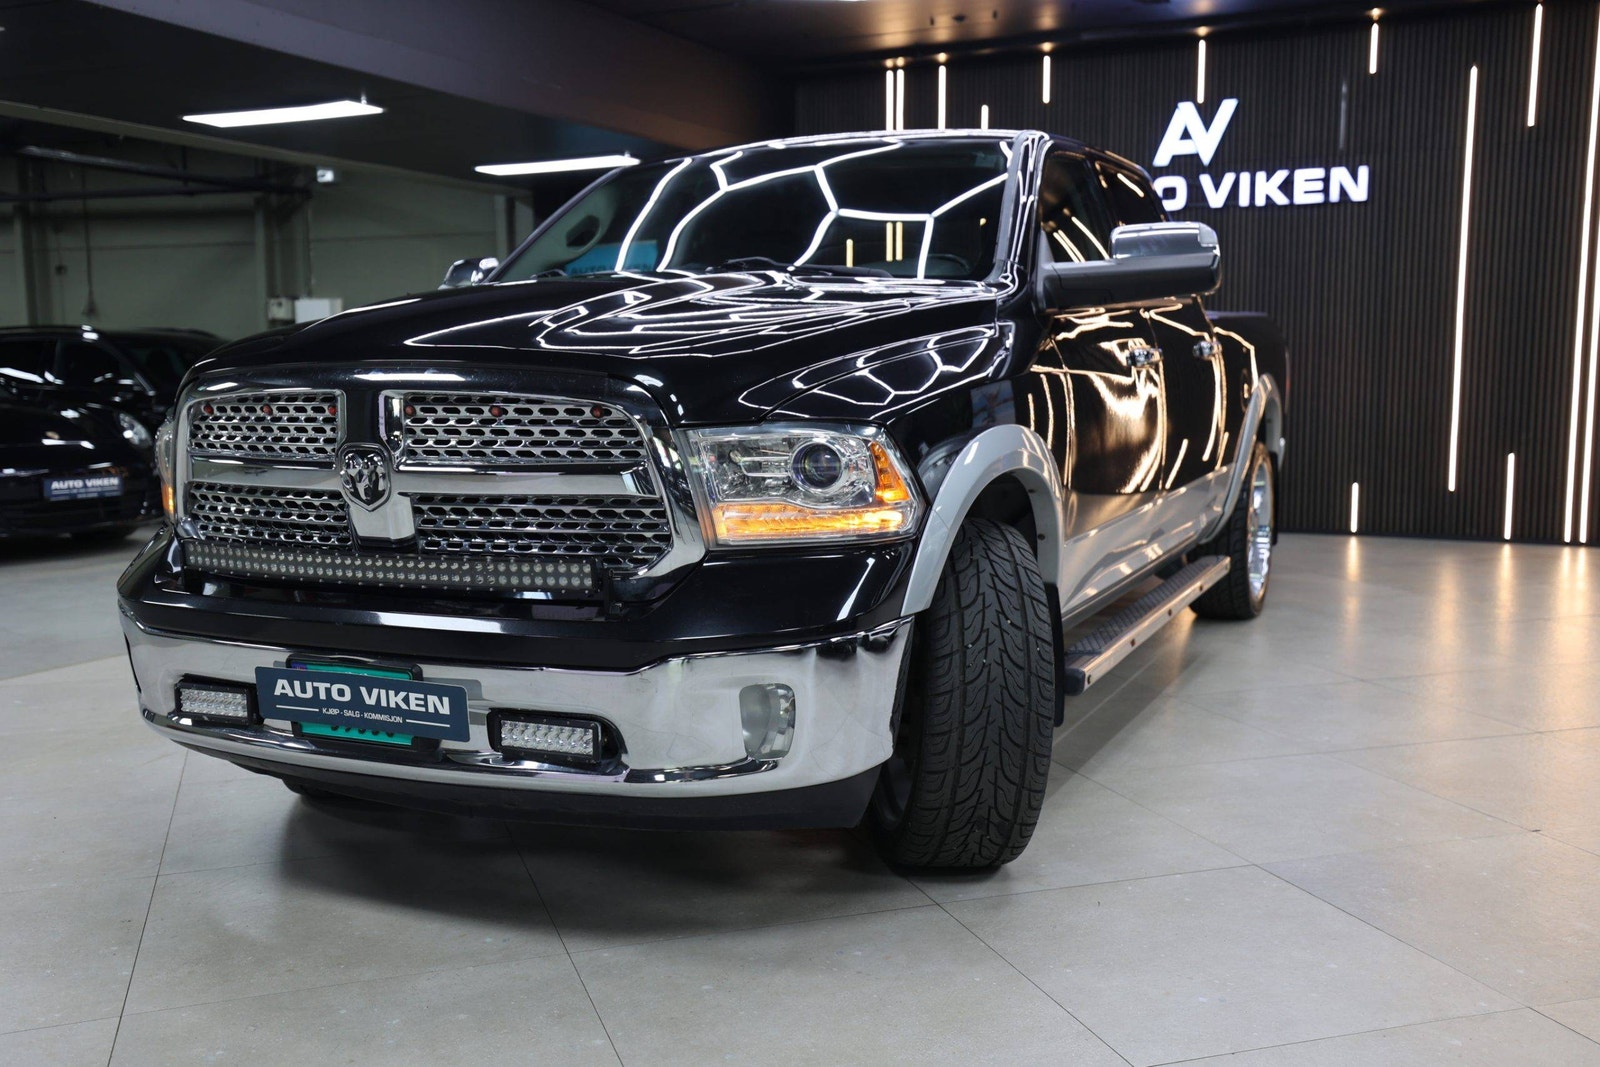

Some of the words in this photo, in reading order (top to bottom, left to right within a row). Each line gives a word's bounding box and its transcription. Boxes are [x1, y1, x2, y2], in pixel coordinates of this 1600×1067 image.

[1198, 165, 1370, 209] VIKEN
[51, 480, 83, 490] AUTO
[85, 477, 118, 487] VIKEN
[274, 679, 351, 702] AUTO
[359, 686, 450, 715] VIKEN
[322, 707, 340, 715] KJØP
[343, 709, 360, 718] SALG
[363, 712, 403, 723] KOMMISJON
